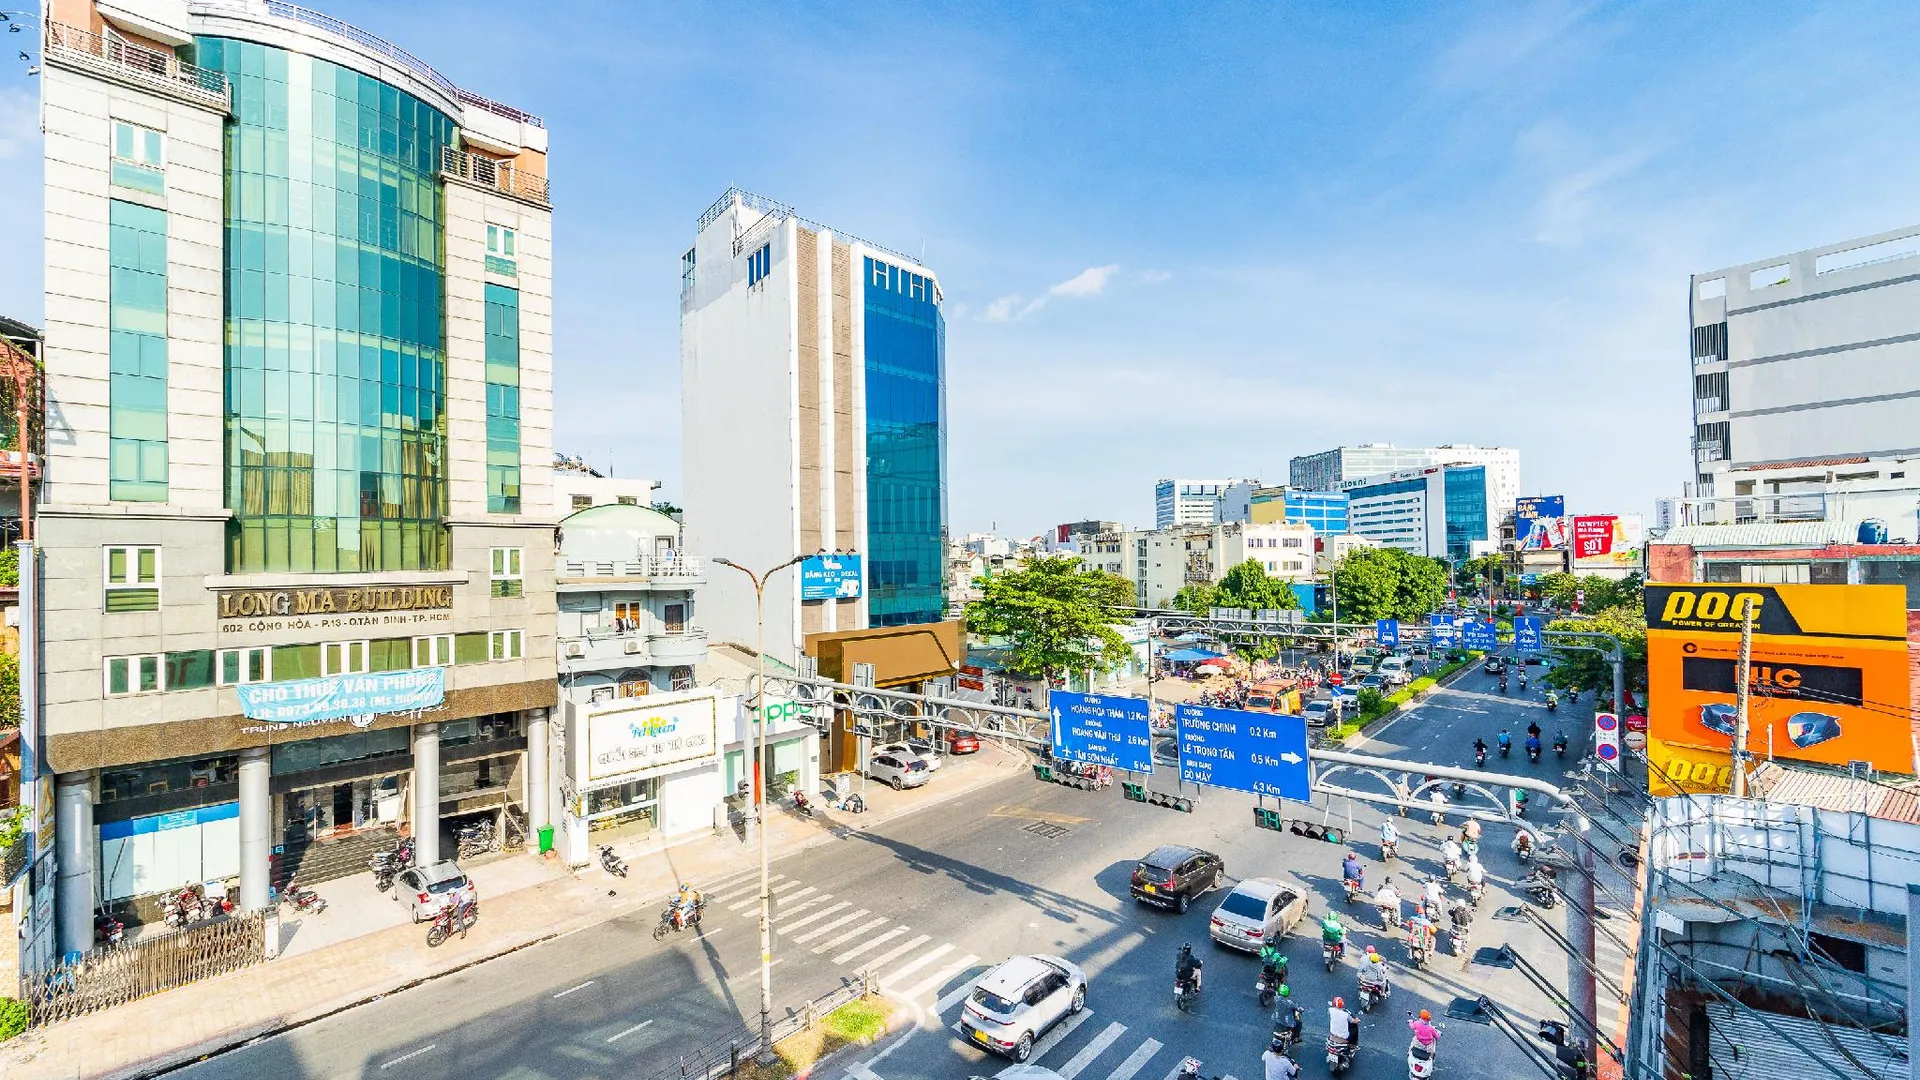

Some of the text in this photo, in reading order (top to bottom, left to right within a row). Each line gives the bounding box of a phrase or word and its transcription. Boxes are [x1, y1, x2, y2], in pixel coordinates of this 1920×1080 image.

[222, 591, 291, 618] LONG
[347, 586, 452, 612] BUILDING
[223, 624, 243, 633] 602
[1672, 619, 1702, 627] POWER
[249, 687, 288, 704] CHO
[1071, 704, 1091, 714] HOÀNG
[1136, 712, 1148, 722] Km
[1138, 736, 1149, 747] Km
[1250, 727, 1261, 737] 0.2
[1263, 728, 1277, 739] Km
[1183, 743, 1192, 754] LÊ
[1251, 753, 1263, 764] 0.5
[1265, 755, 1279, 767] Km
[1140, 761, 1151, 772] Km
[1184, 768, 1194, 779] GÒ
[1253, 781, 1264, 792] 4.3
[1266, 783, 1280, 795] Km
[1257, 808, 1280, 829] 74
